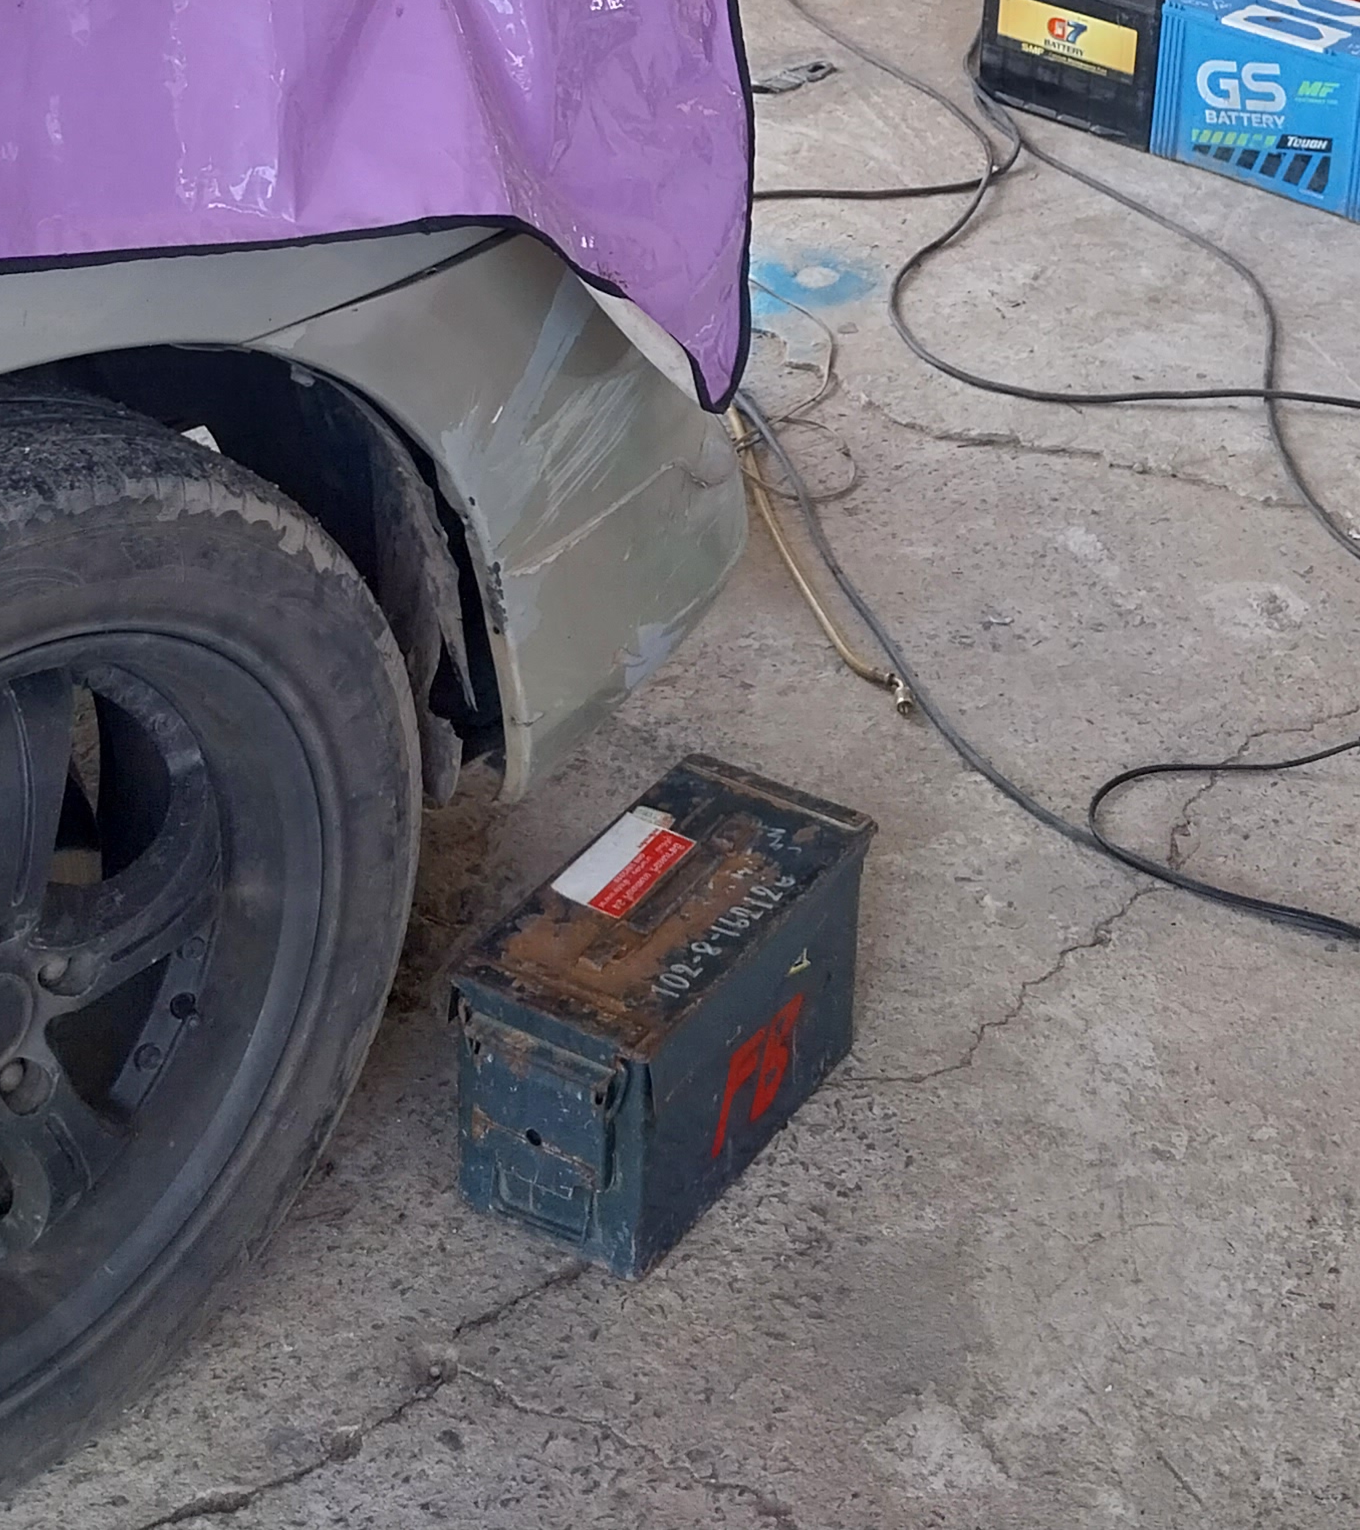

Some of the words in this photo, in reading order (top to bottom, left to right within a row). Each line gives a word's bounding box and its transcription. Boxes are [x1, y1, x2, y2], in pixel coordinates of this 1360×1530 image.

[1047, 17, 1088, 44] G7
[1044, 39, 1084, 57] BATTERY
[1196, 60, 1286, 113] GS
[1296, 81, 1339, 97] MF
[1205, 110, 1285, 129] BATTERY
[1287, 135, 1328, 149] TOUGH
[711, 993, 804, 1160] FB
